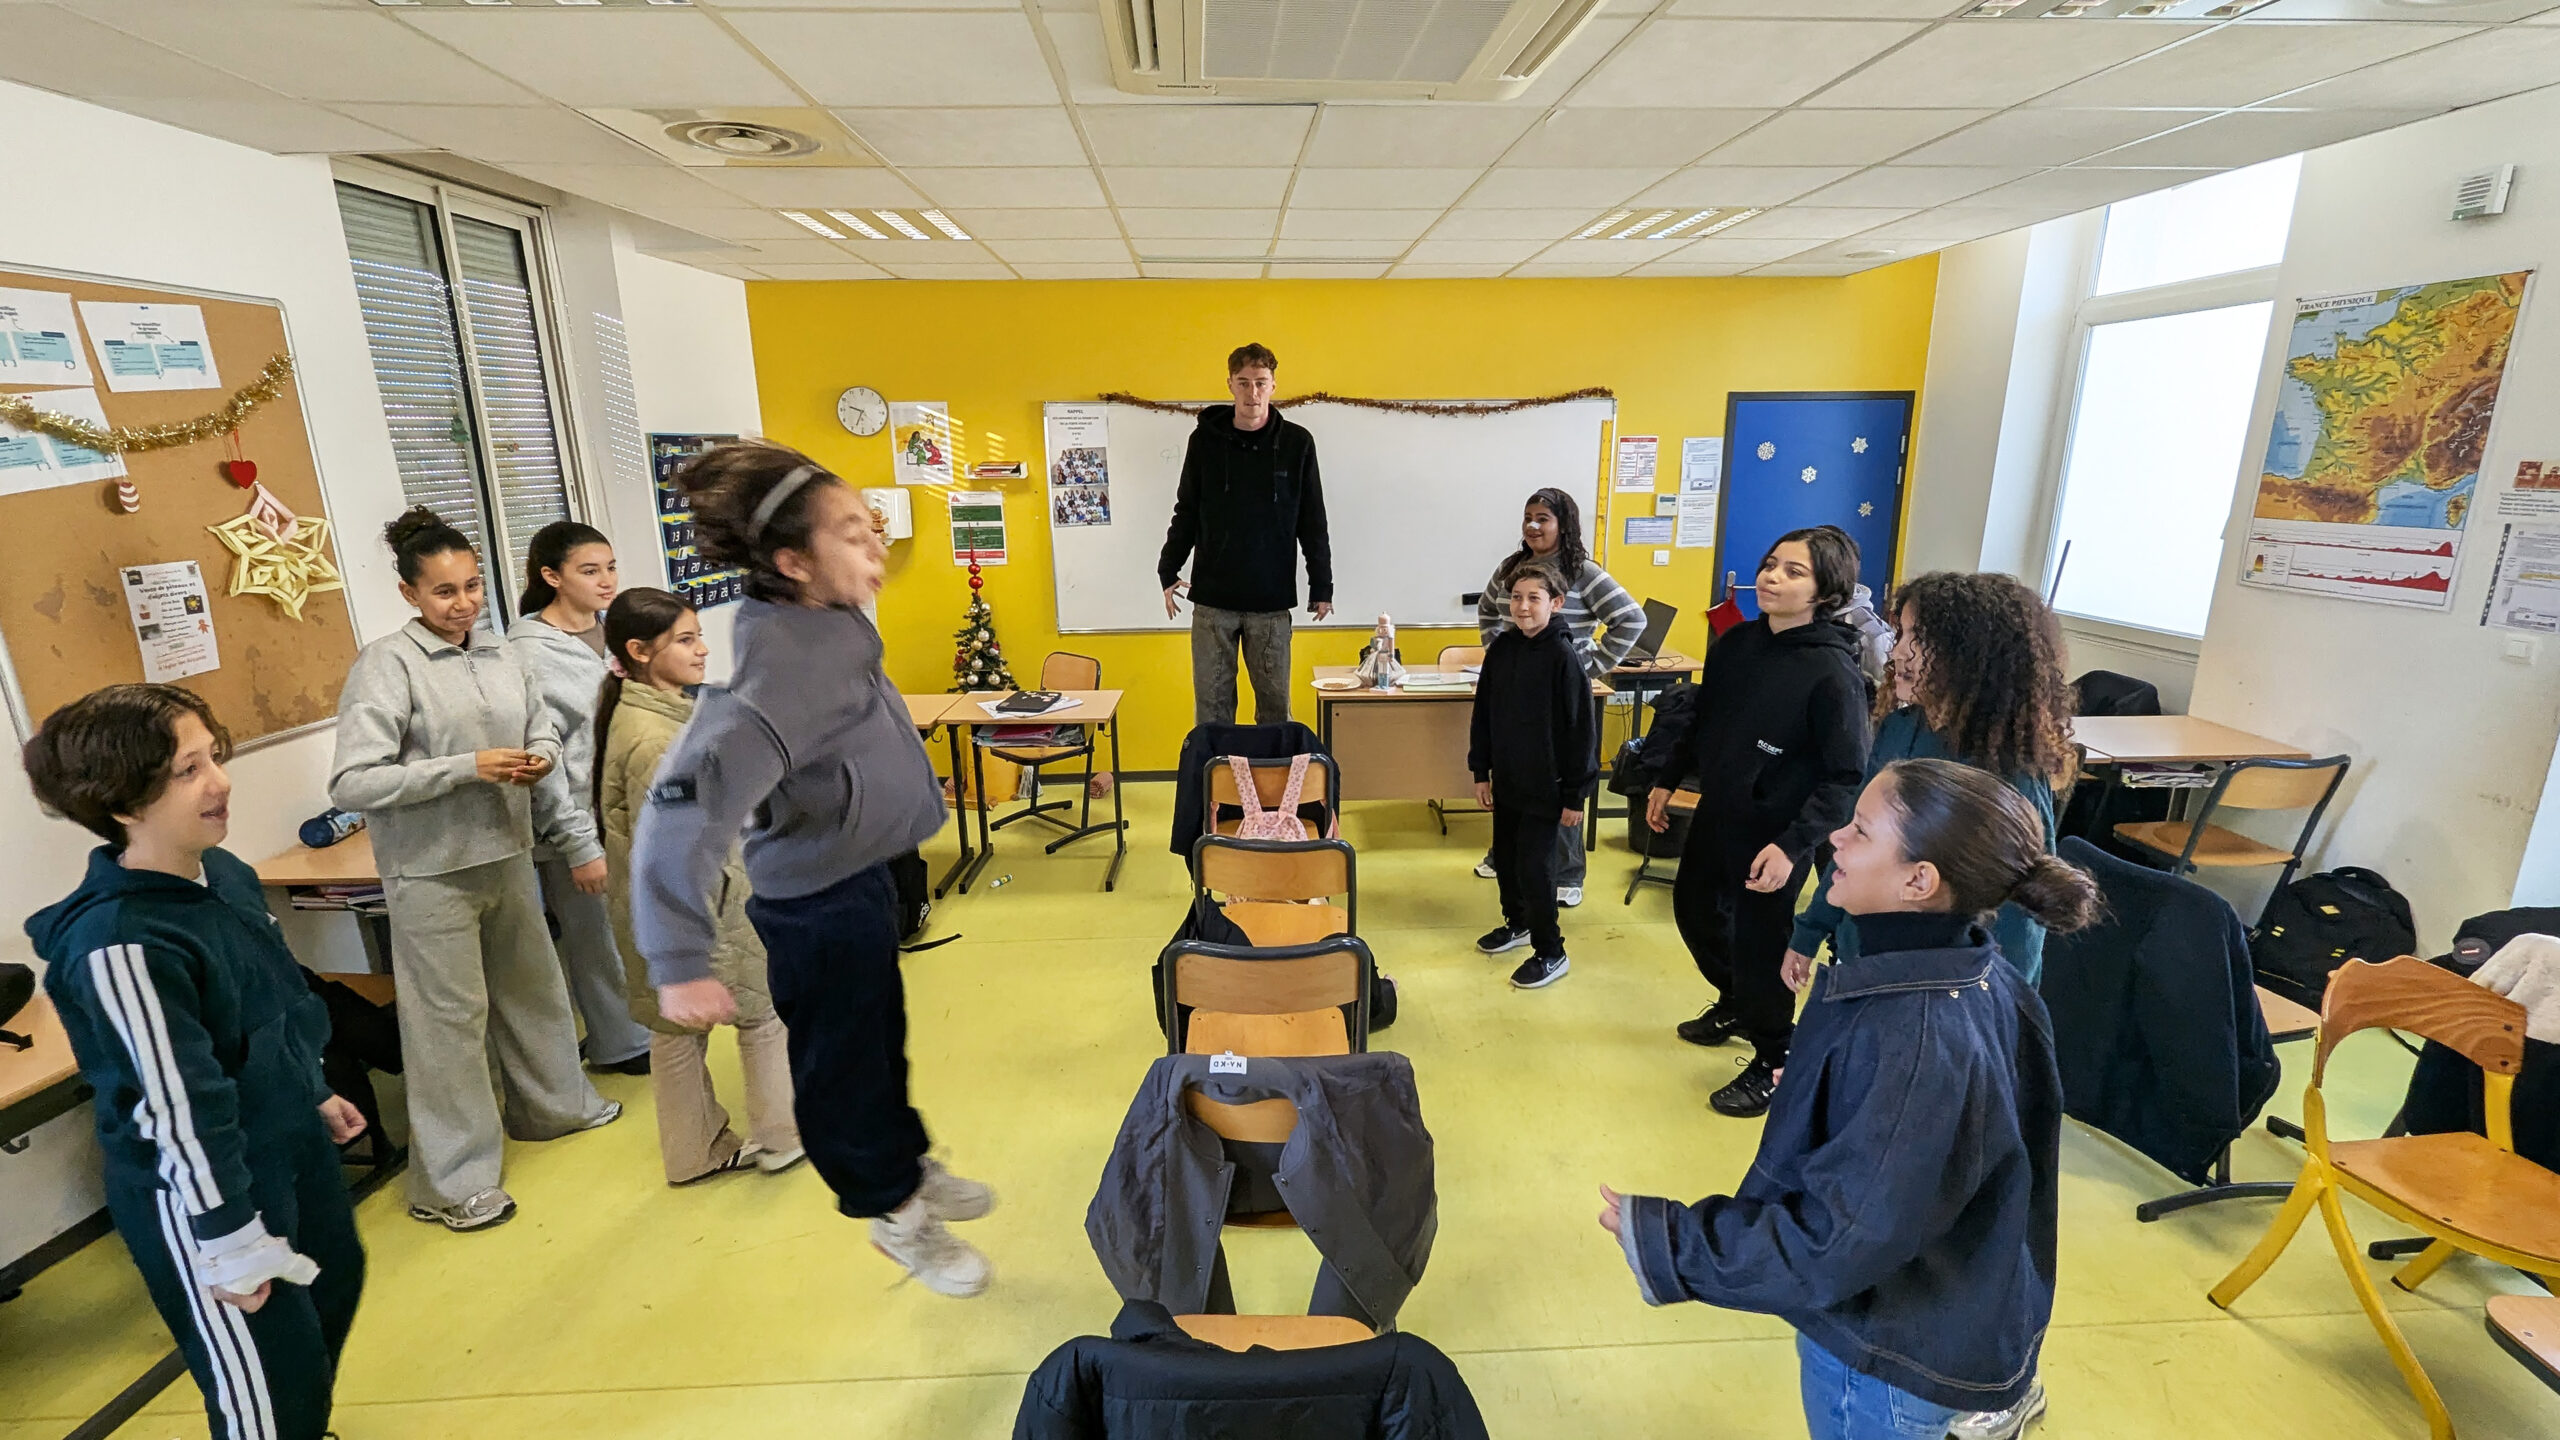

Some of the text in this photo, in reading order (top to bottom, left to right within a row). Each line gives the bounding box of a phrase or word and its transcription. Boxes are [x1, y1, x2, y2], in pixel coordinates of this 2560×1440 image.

[2300, 295, 2374, 311] FRANCE PHYSIQUE
[662, 464, 671, 475] 01
[666, 498, 675, 509] 07
[672, 530, 680, 543] 13
[691, 562, 701, 573] 20
[695, 593, 704, 605] 26
[708, 589, 718, 602] 27
